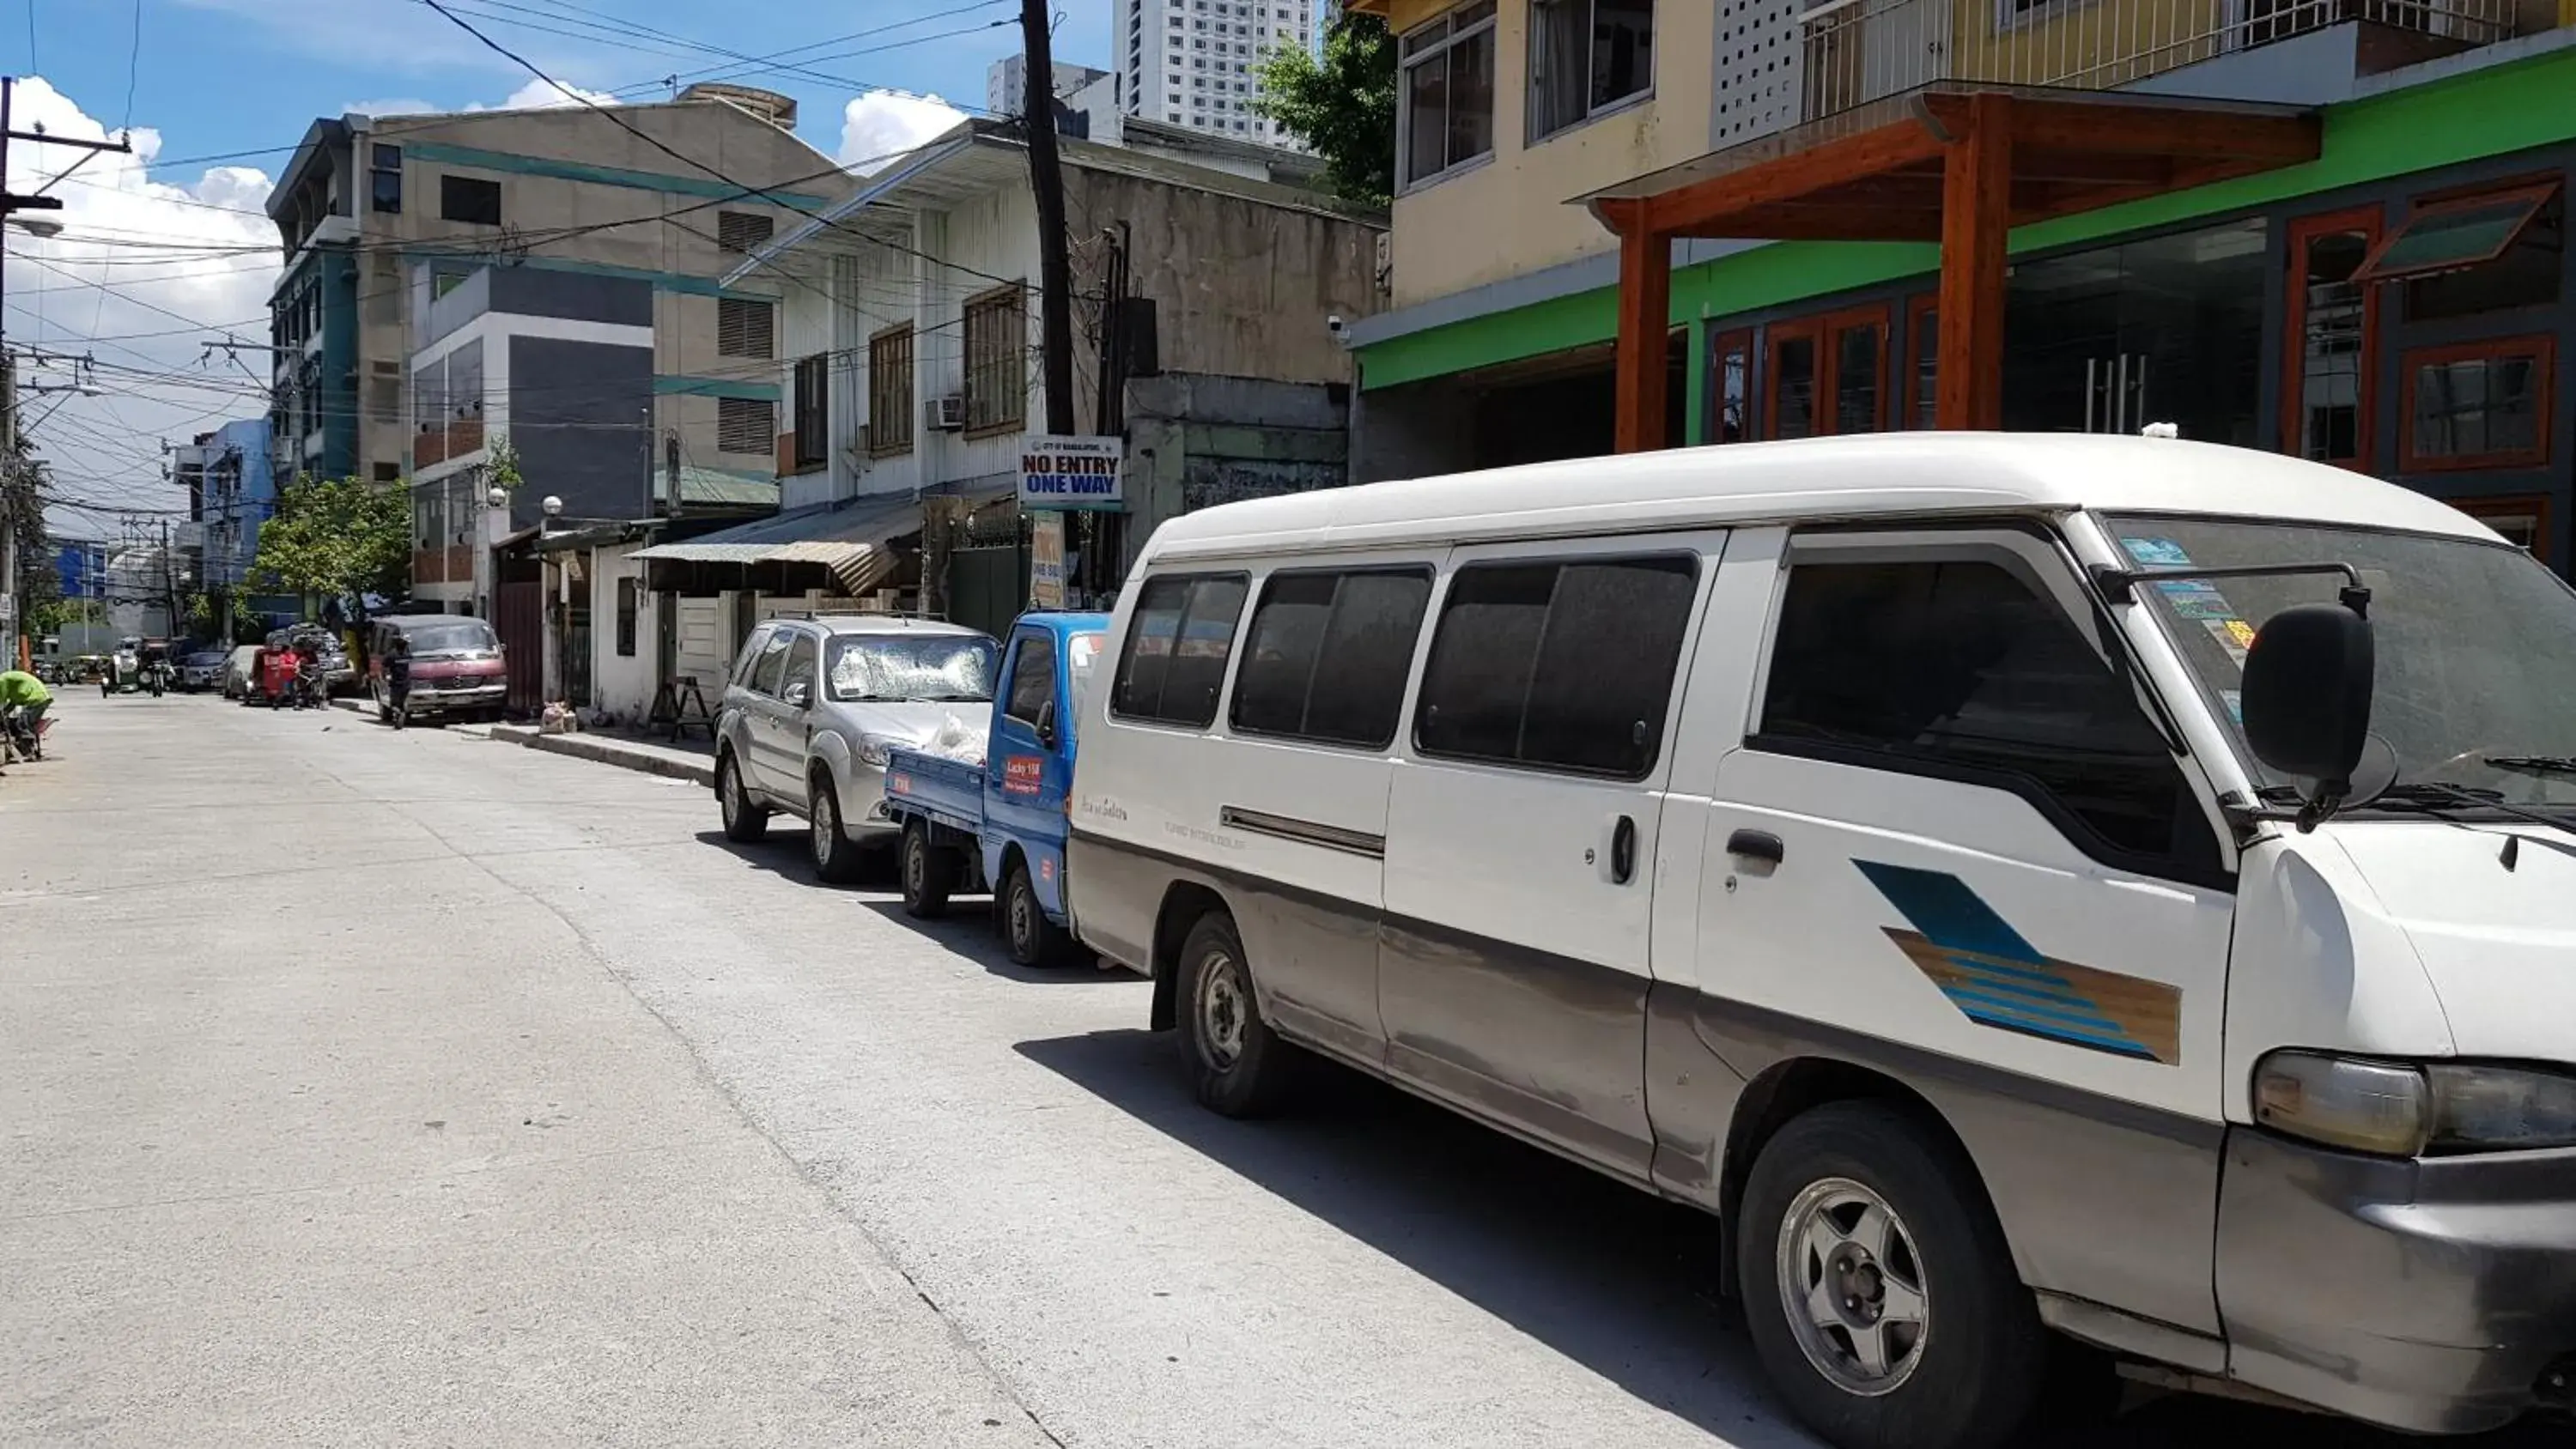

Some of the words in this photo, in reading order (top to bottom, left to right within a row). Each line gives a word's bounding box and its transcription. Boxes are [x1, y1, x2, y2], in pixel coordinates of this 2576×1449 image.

[1022, 455, 1051, 473] NO
[1055, 456, 1118, 474] ENTRY
[1027, 475, 1066, 493] ONE
[1070, 476, 1115, 494] WAY
